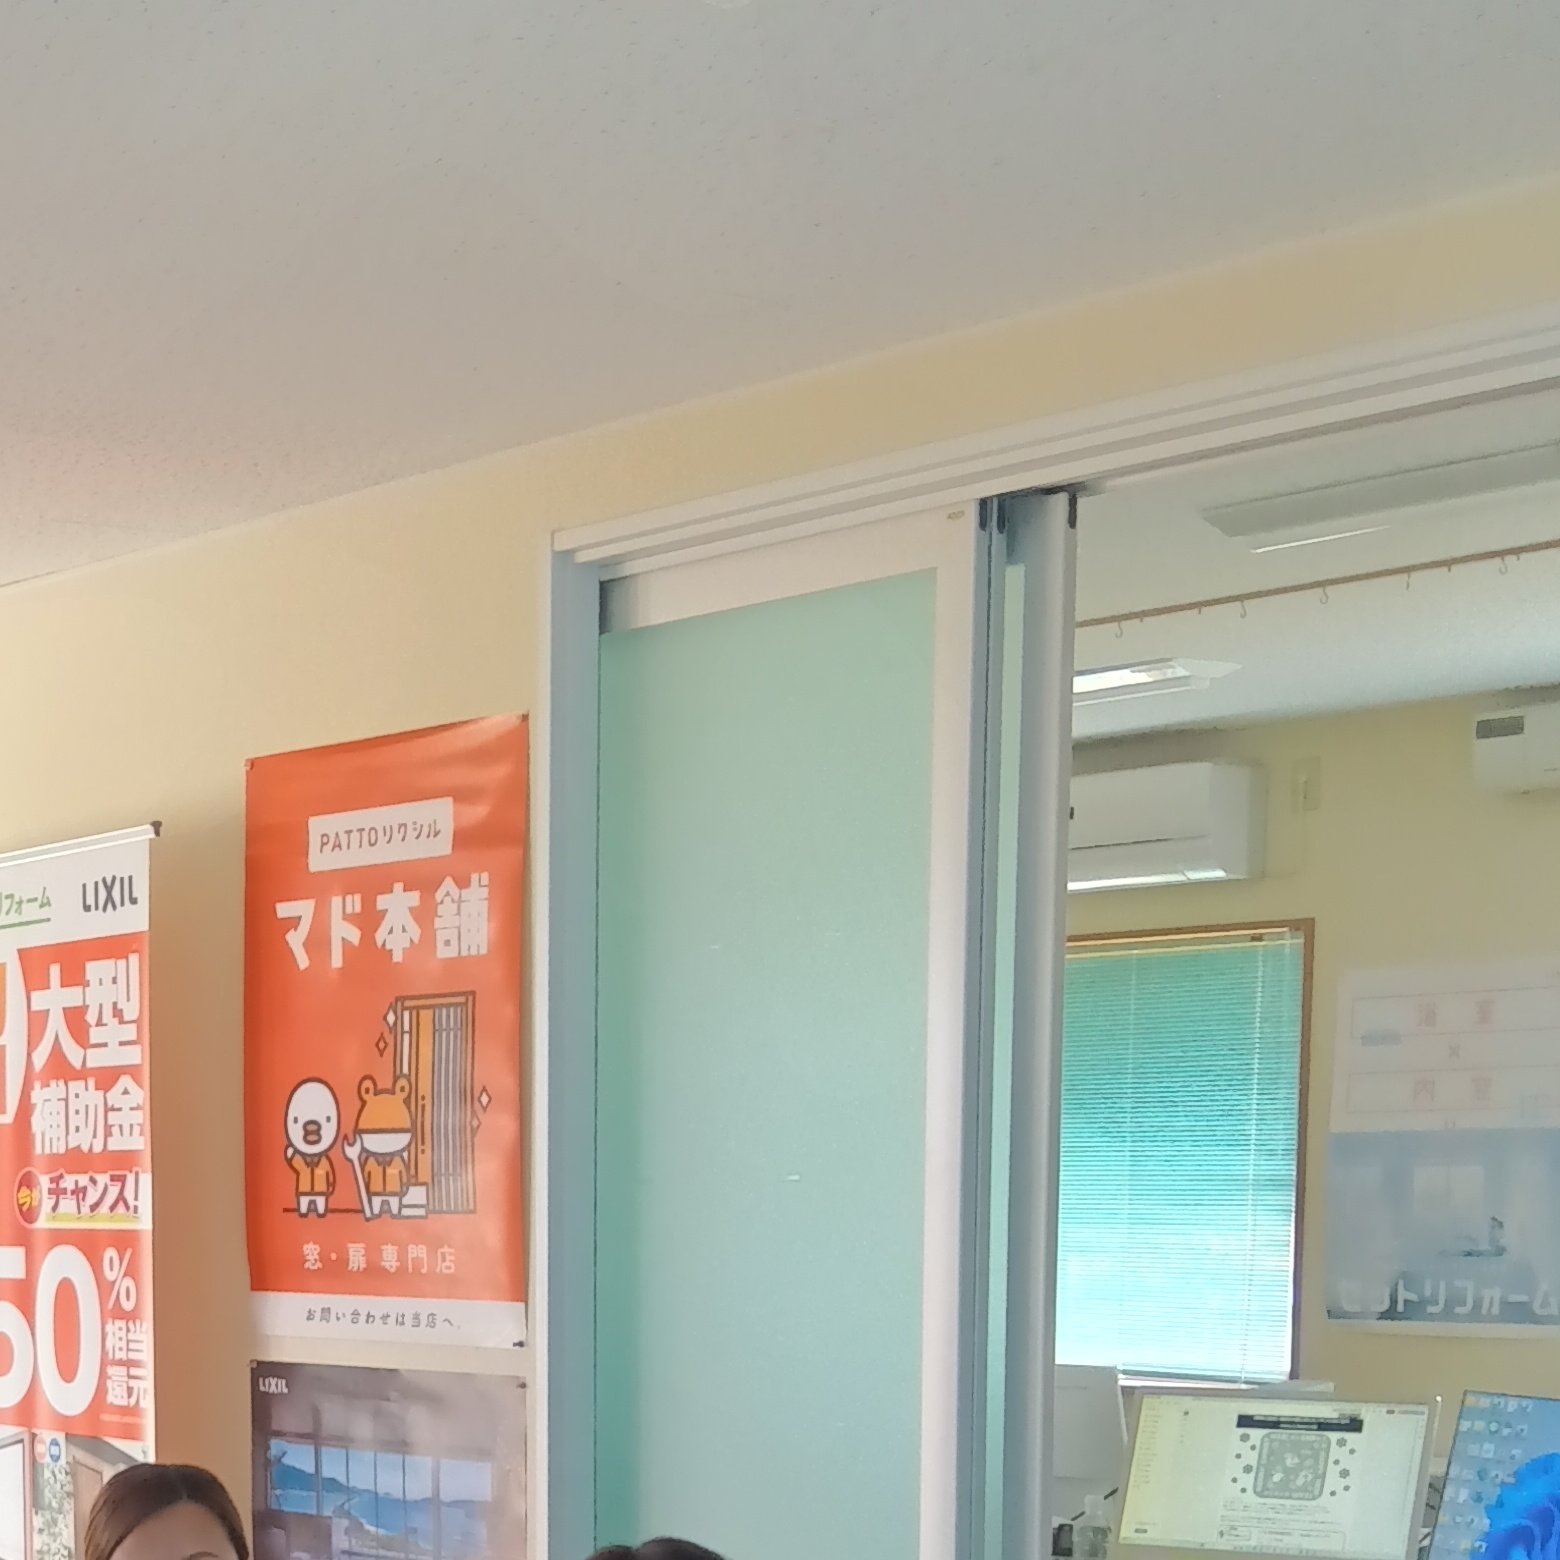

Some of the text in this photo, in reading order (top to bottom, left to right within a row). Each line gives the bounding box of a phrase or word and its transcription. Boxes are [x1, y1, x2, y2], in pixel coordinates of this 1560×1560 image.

[319, 818, 441, 854] PATTOリクシル
[81, 875, 138, 914] LIXIL
[275, 871, 489, 971] マド本舗
[30, 952, 142, 1071] 大型
[30, 1074, 145, 1155] 補助金
[258, 1376, 289, 1394] LIXIL
